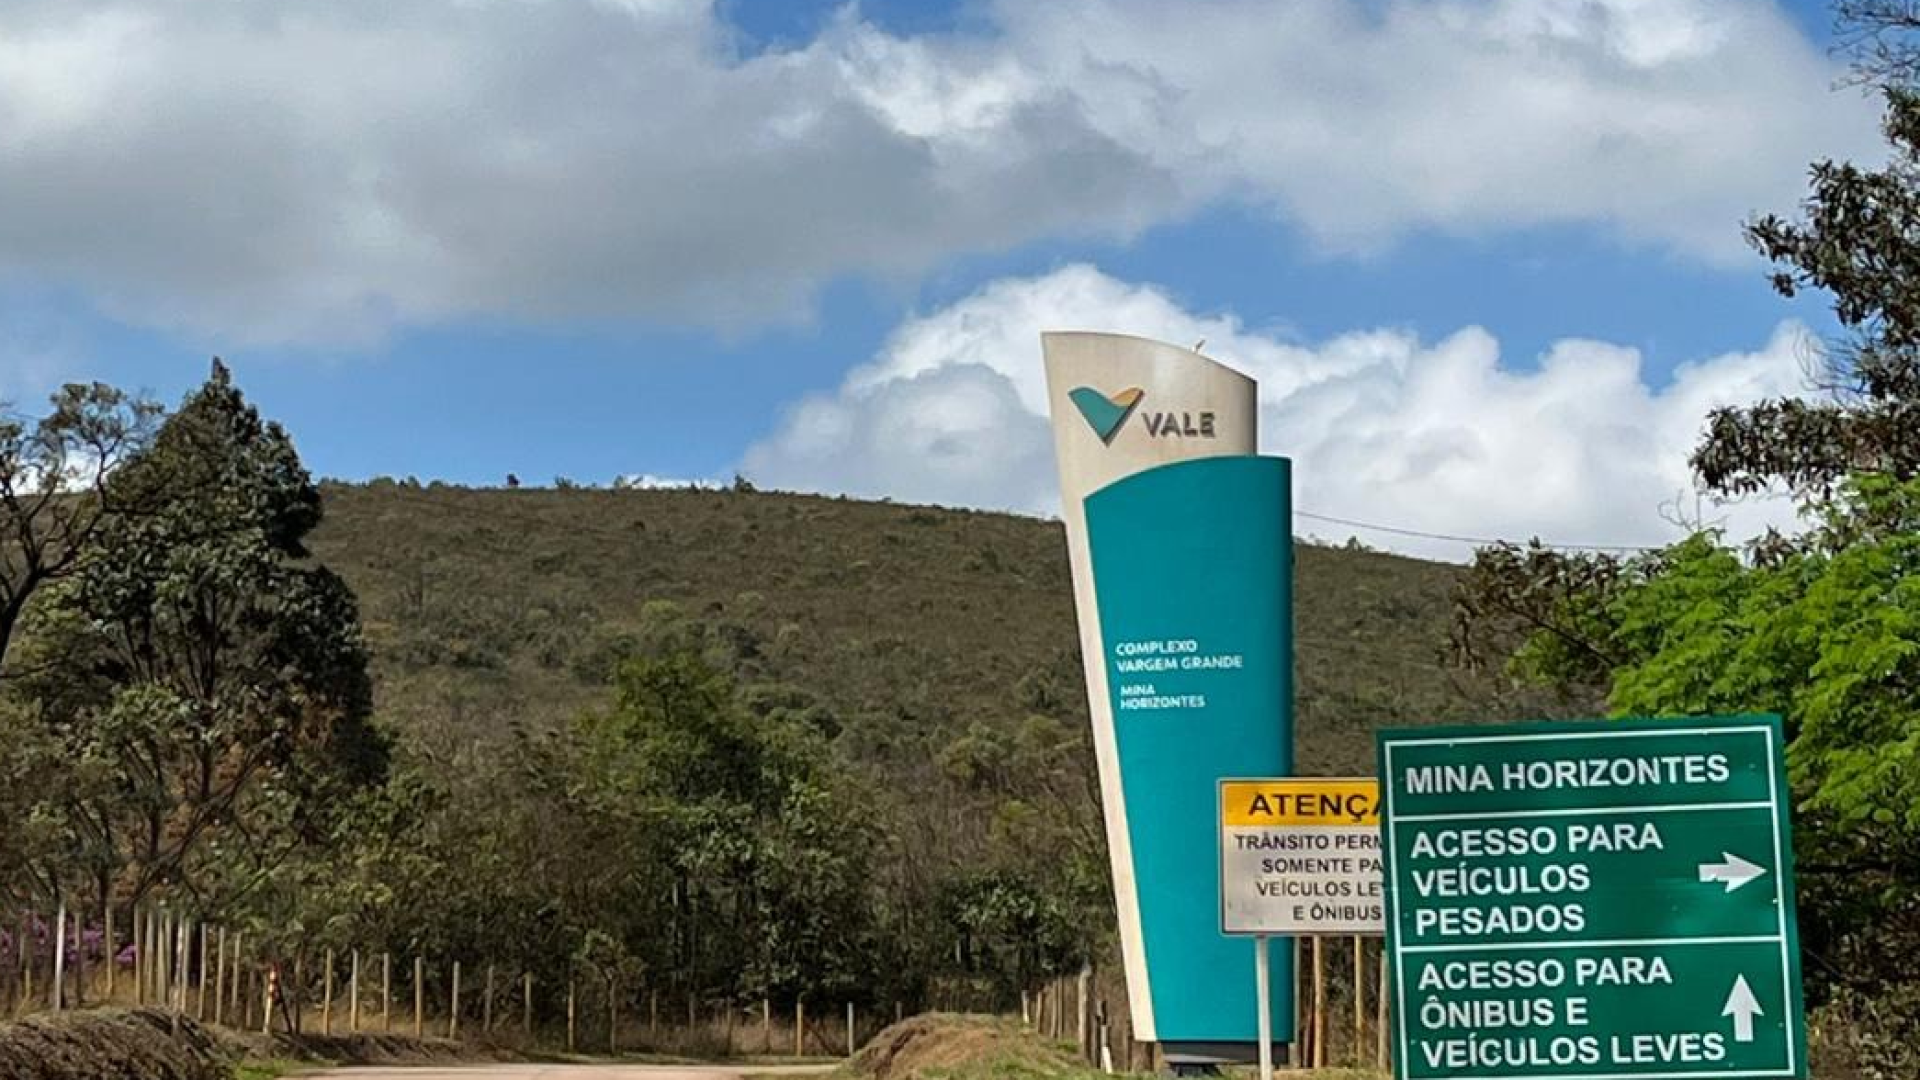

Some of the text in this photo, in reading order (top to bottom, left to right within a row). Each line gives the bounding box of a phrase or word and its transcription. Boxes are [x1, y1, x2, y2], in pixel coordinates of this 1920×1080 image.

[1142, 412, 1216, 438] VALE
[1115, 639, 1198, 656] COMPLEXO
[1115, 655, 1243, 673] VARGEM GRANDE
[1120, 684, 1156, 697] MINA
[1120, 695, 1206, 710] HORIZONTES
[1405, 754, 1730, 794] MINA HORIZONTES
[1248, 793, 1380, 823] ATENÇ
[1234, 831, 1329, 850] TRÂNSITO
[1410, 822, 1663, 859] ACESSO PARA
[1261, 858, 1384, 873] SOMENTE PA
[1256, 878, 1385, 897] VEÍCULOS LE
[1411, 862, 1591, 897] VEÍCULOS
[1293, 902, 1382, 920] E ÔNIBUS
[1415, 904, 1586, 936] PESADOS
[1417, 956, 1673, 991] ACESSO PARA
[1420, 995, 1589, 1030] ÔNIBUS E
[1420, 1032, 1726, 1068] VEÍCULOS LEVES
